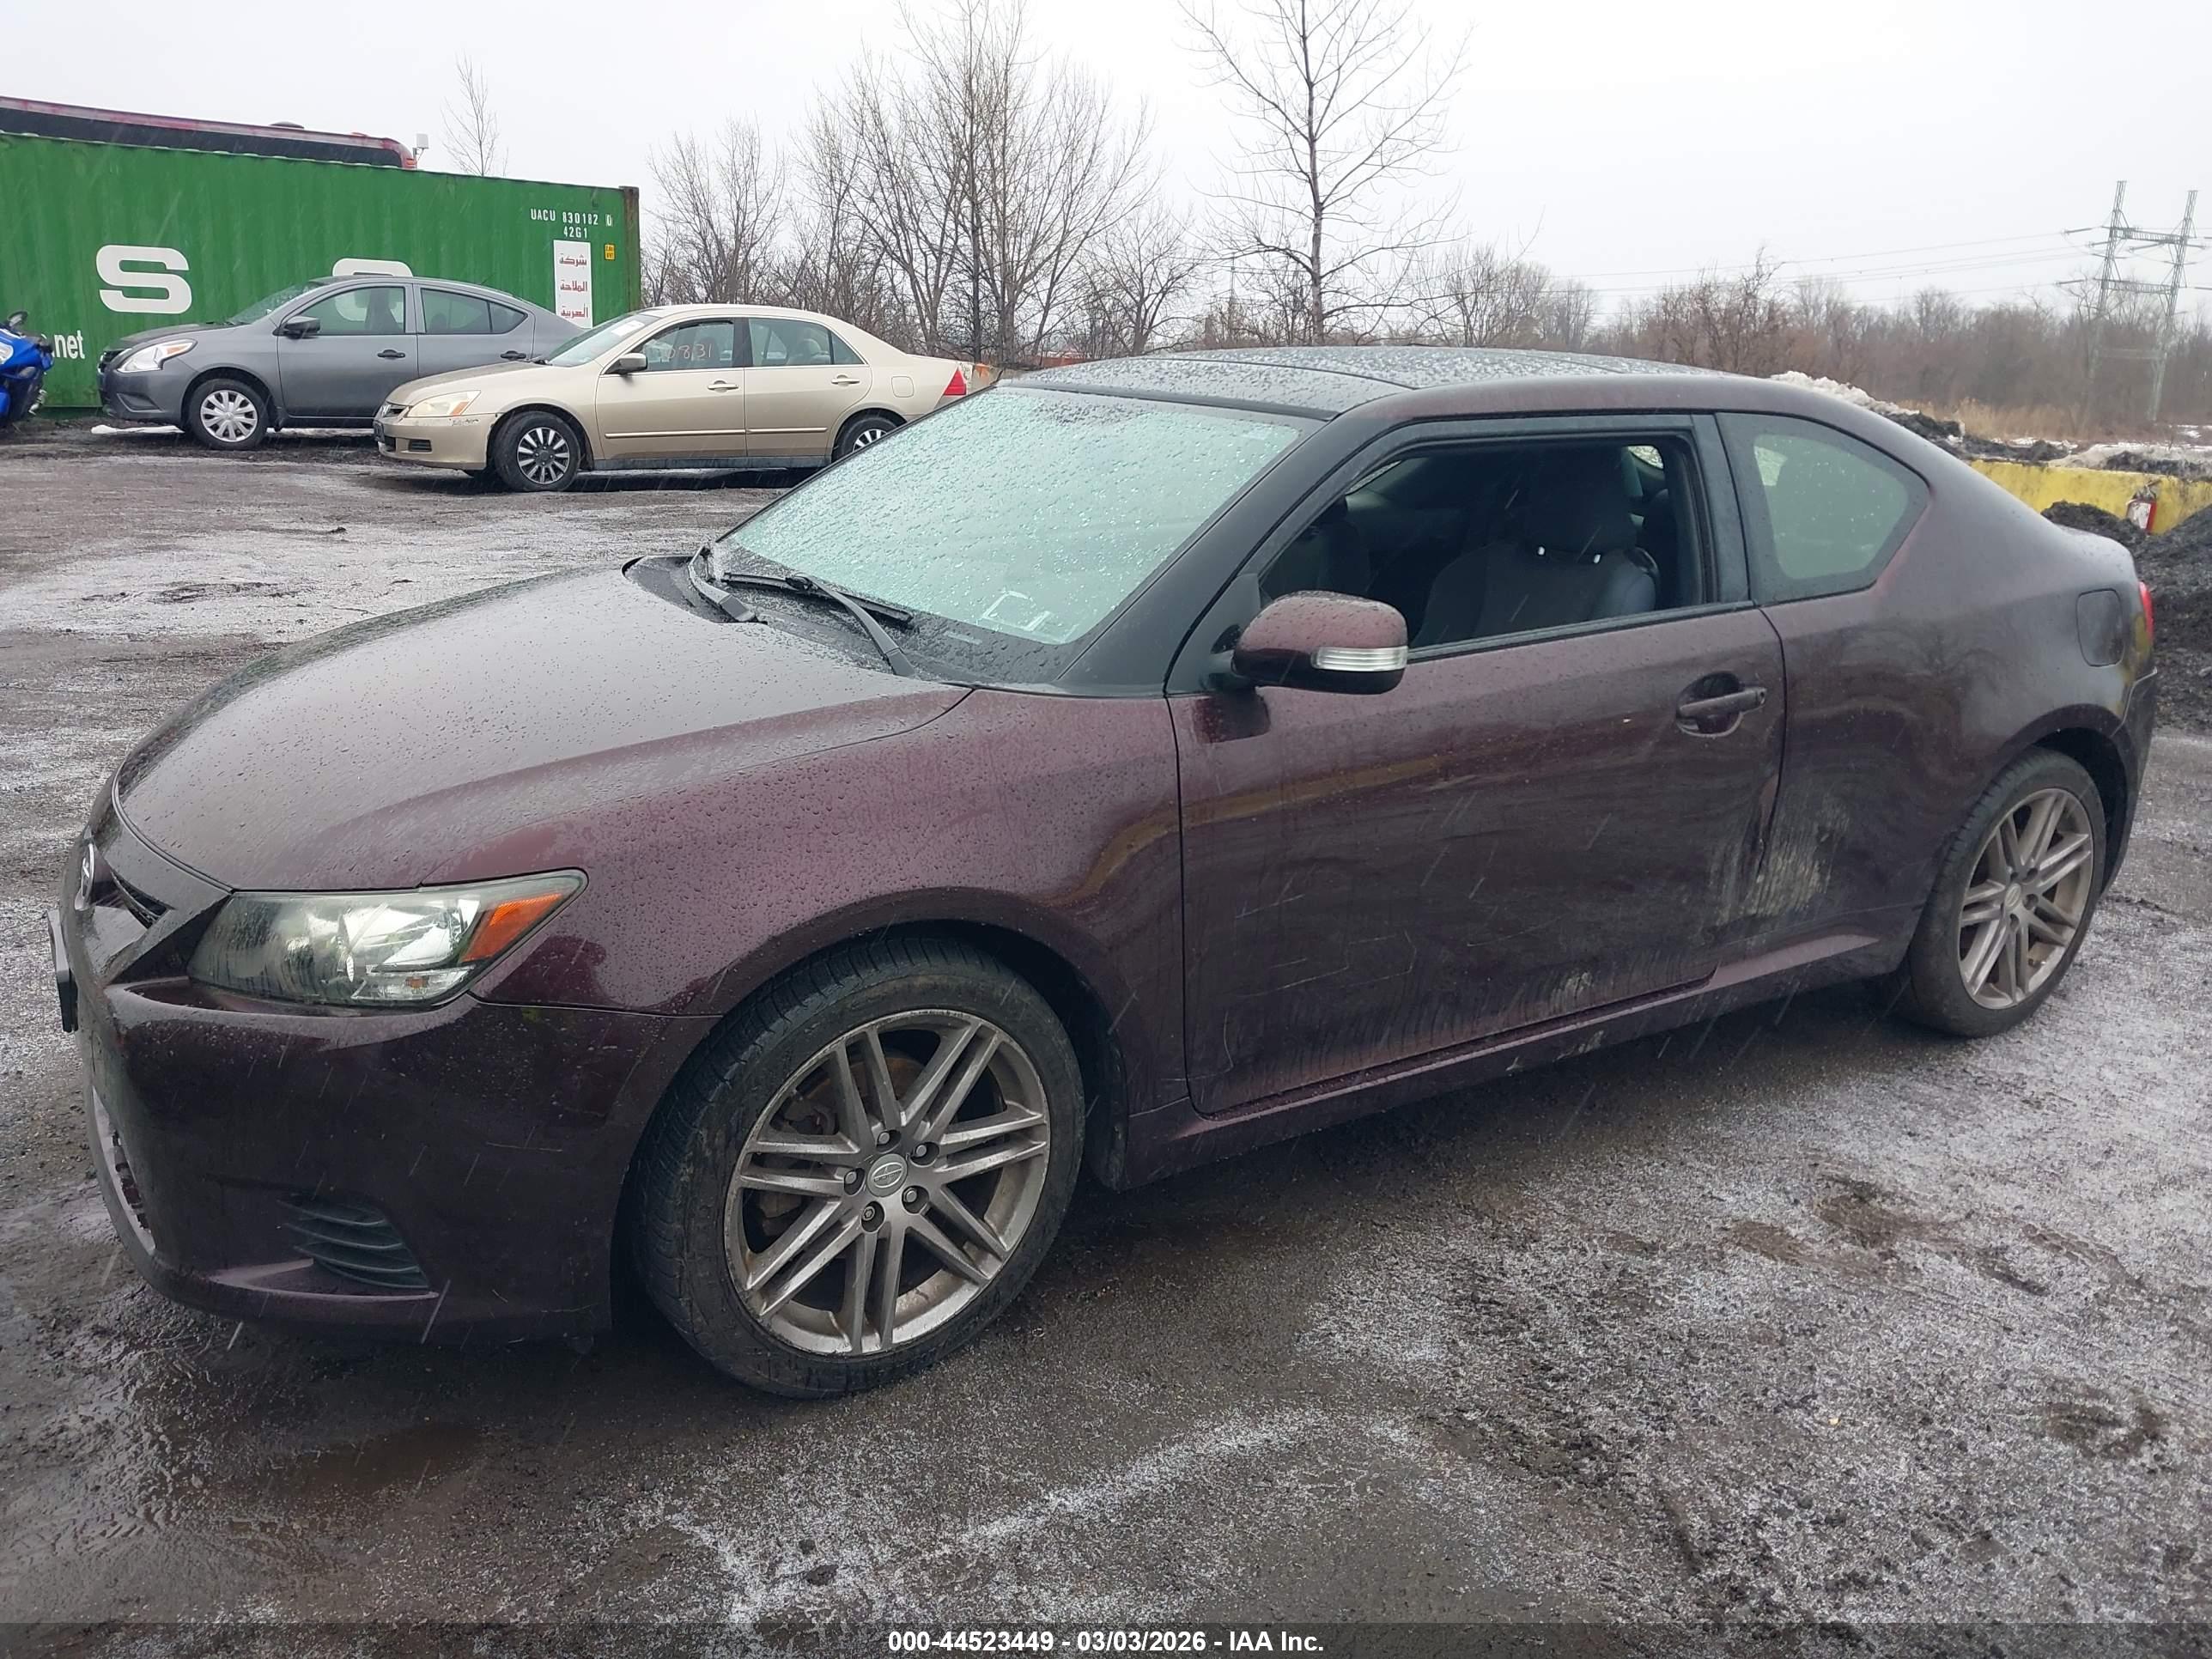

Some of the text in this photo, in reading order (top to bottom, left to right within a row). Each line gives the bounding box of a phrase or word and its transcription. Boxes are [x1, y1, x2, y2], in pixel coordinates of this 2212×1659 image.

[530, 208, 556, 222] UACU
[562, 211, 599, 226] 830182
[563, 226, 587, 239] 42G1
[95, 244, 192, 314] S
[560, 279, 588, 293] الملاحة
[561, 303, 589, 319] العربية
